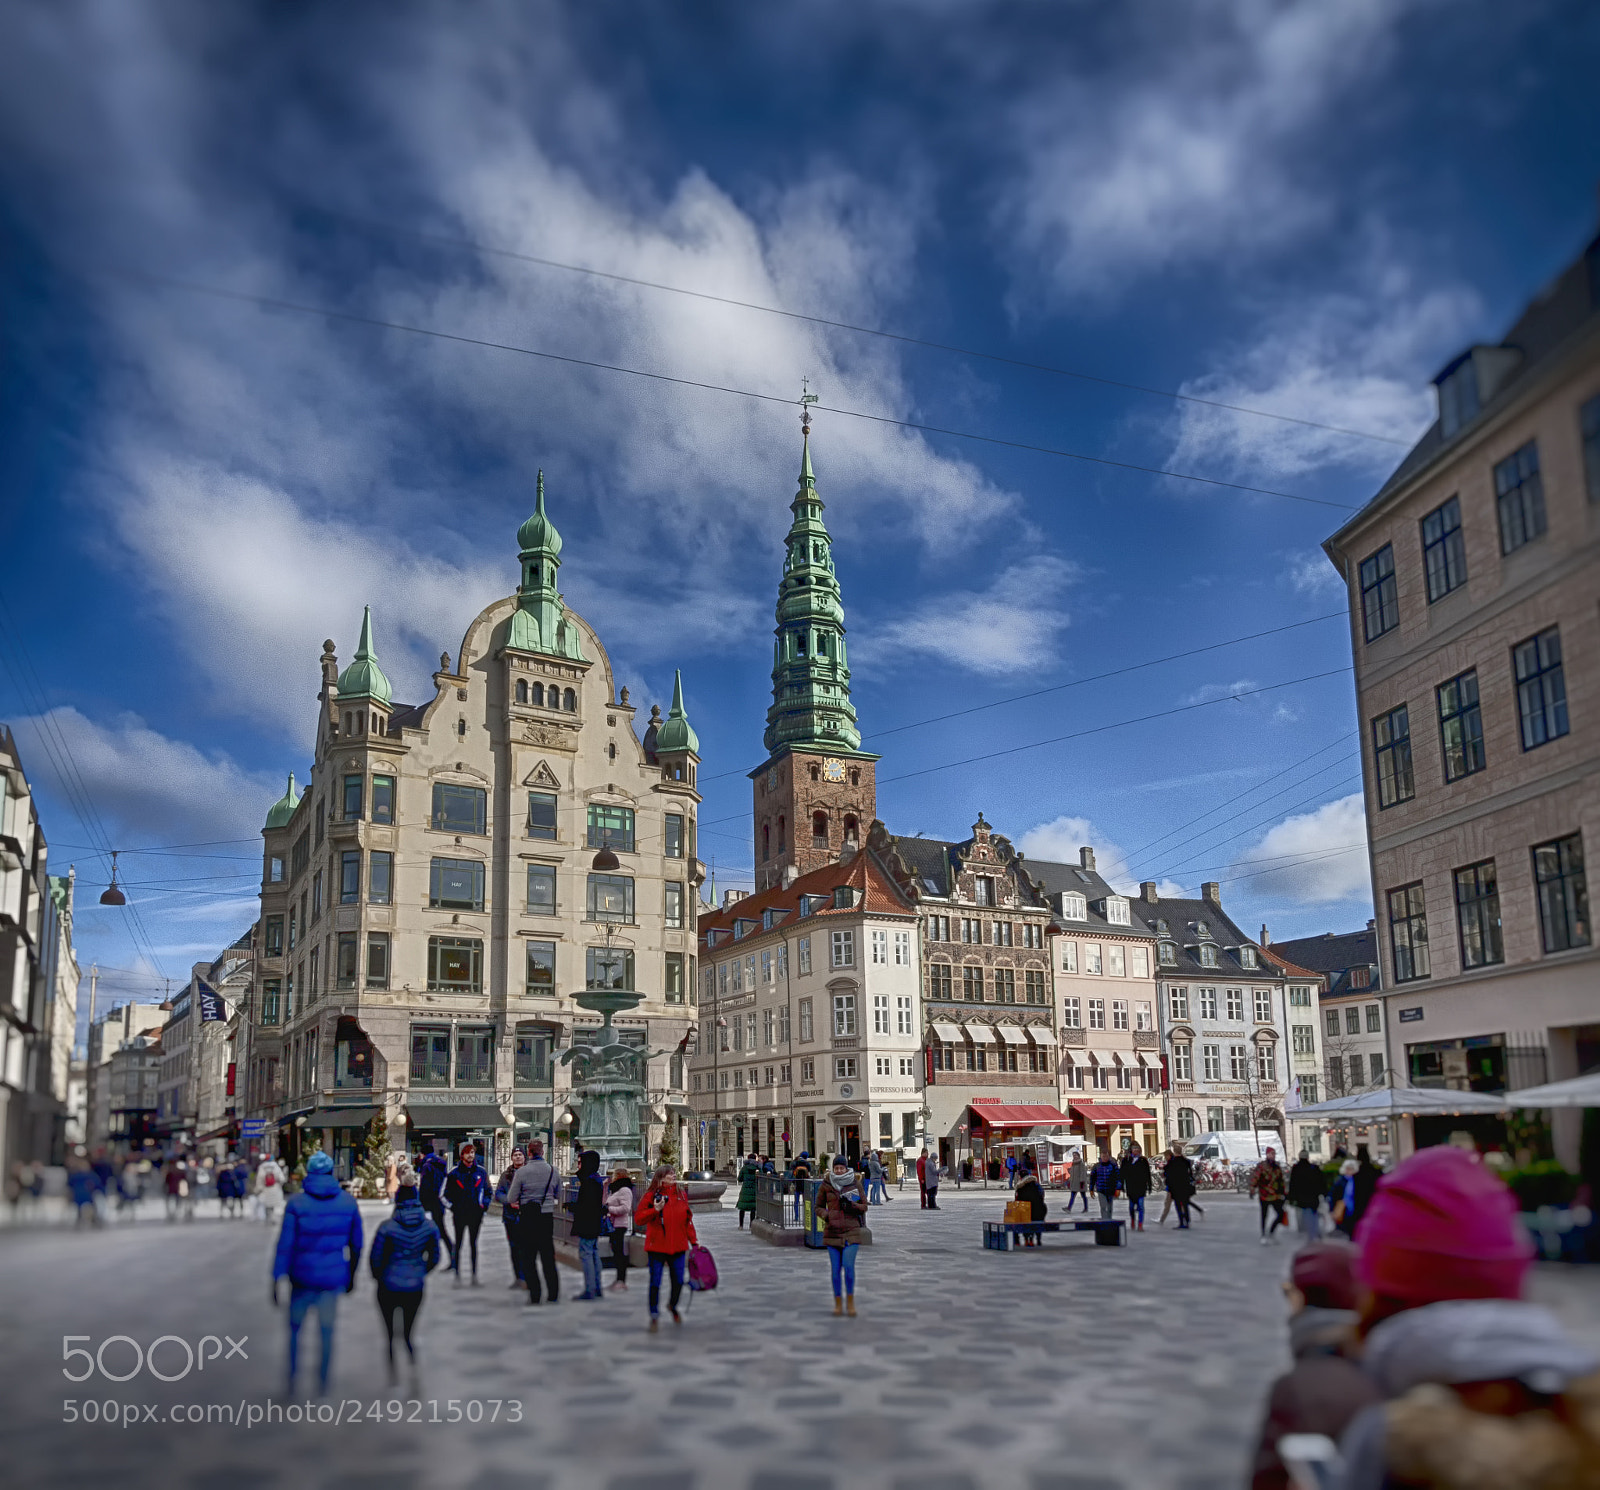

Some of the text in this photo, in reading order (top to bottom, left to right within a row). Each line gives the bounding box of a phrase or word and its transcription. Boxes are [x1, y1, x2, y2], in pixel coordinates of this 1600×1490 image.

[201, 993, 217, 1021] HAY
[793, 1089, 824, 1098] ESPRESSO HOUSE
